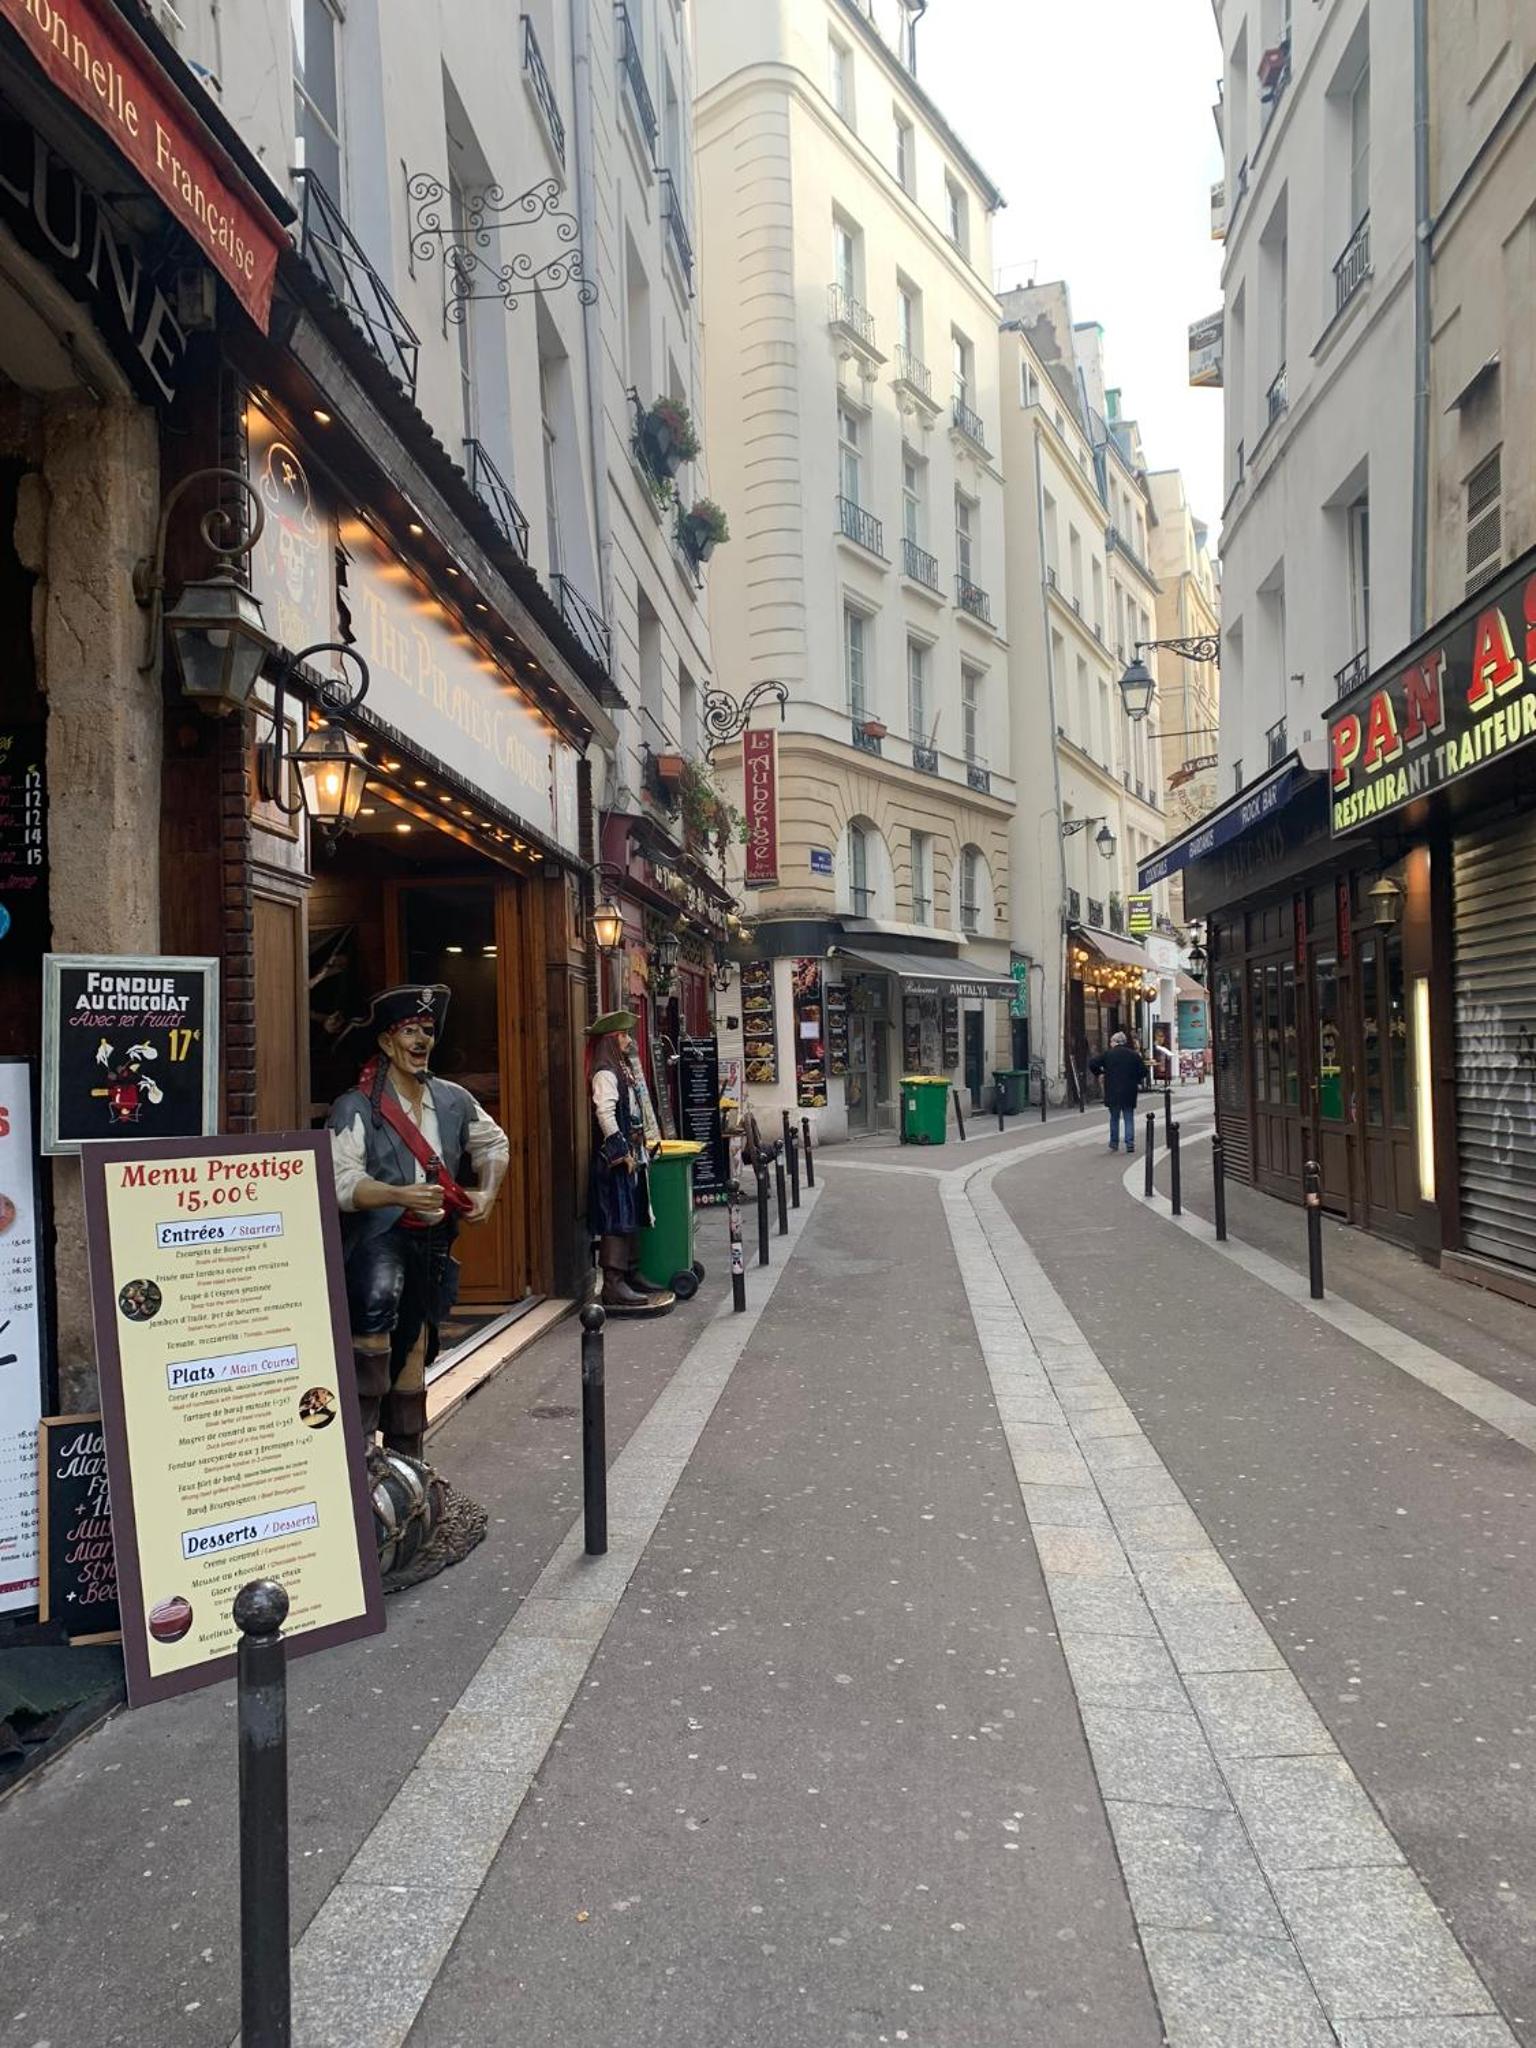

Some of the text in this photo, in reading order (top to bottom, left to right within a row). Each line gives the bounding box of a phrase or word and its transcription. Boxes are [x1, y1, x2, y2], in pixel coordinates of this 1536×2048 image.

[155, 119, 256, 279] Française
[1332, 648, 1447, 792] PAN
[1334, 692, 1536, 831] RESTAURANT TRAITEUR
[25, 771, 41, 789] 12
[25, 791, 42, 807] 12
[1241, 798, 1261, 826] ROCK
[1262, 784, 1278, 814] BAR
[25, 809, 41, 826] 12
[25, 828, 42, 844] 14
[27, 849, 42, 865] 15
[87, 972, 174, 993] FONDUE
[950, 983, 988, 996] ANTALYA
[75, 994, 104, 1010] AU
[69, 1010, 117, 1027] Avec
[140, 1010, 186, 1027] fruits
[120, 1156, 304, 1188] Menu Prestige
[177, 1182, 259, 1212] 15,00€
[162, 1225, 224, 1244] Entrées
[239, 1224, 281, 1237] Starters
[172, 1366, 215, 1385] Plats
[230, 1362, 258, 1376] Main
[262, 1356, 296, 1371] Course
[187, 1525, 258, 1554] Desserts
[272, 1514, 316, 1533] Desserts
